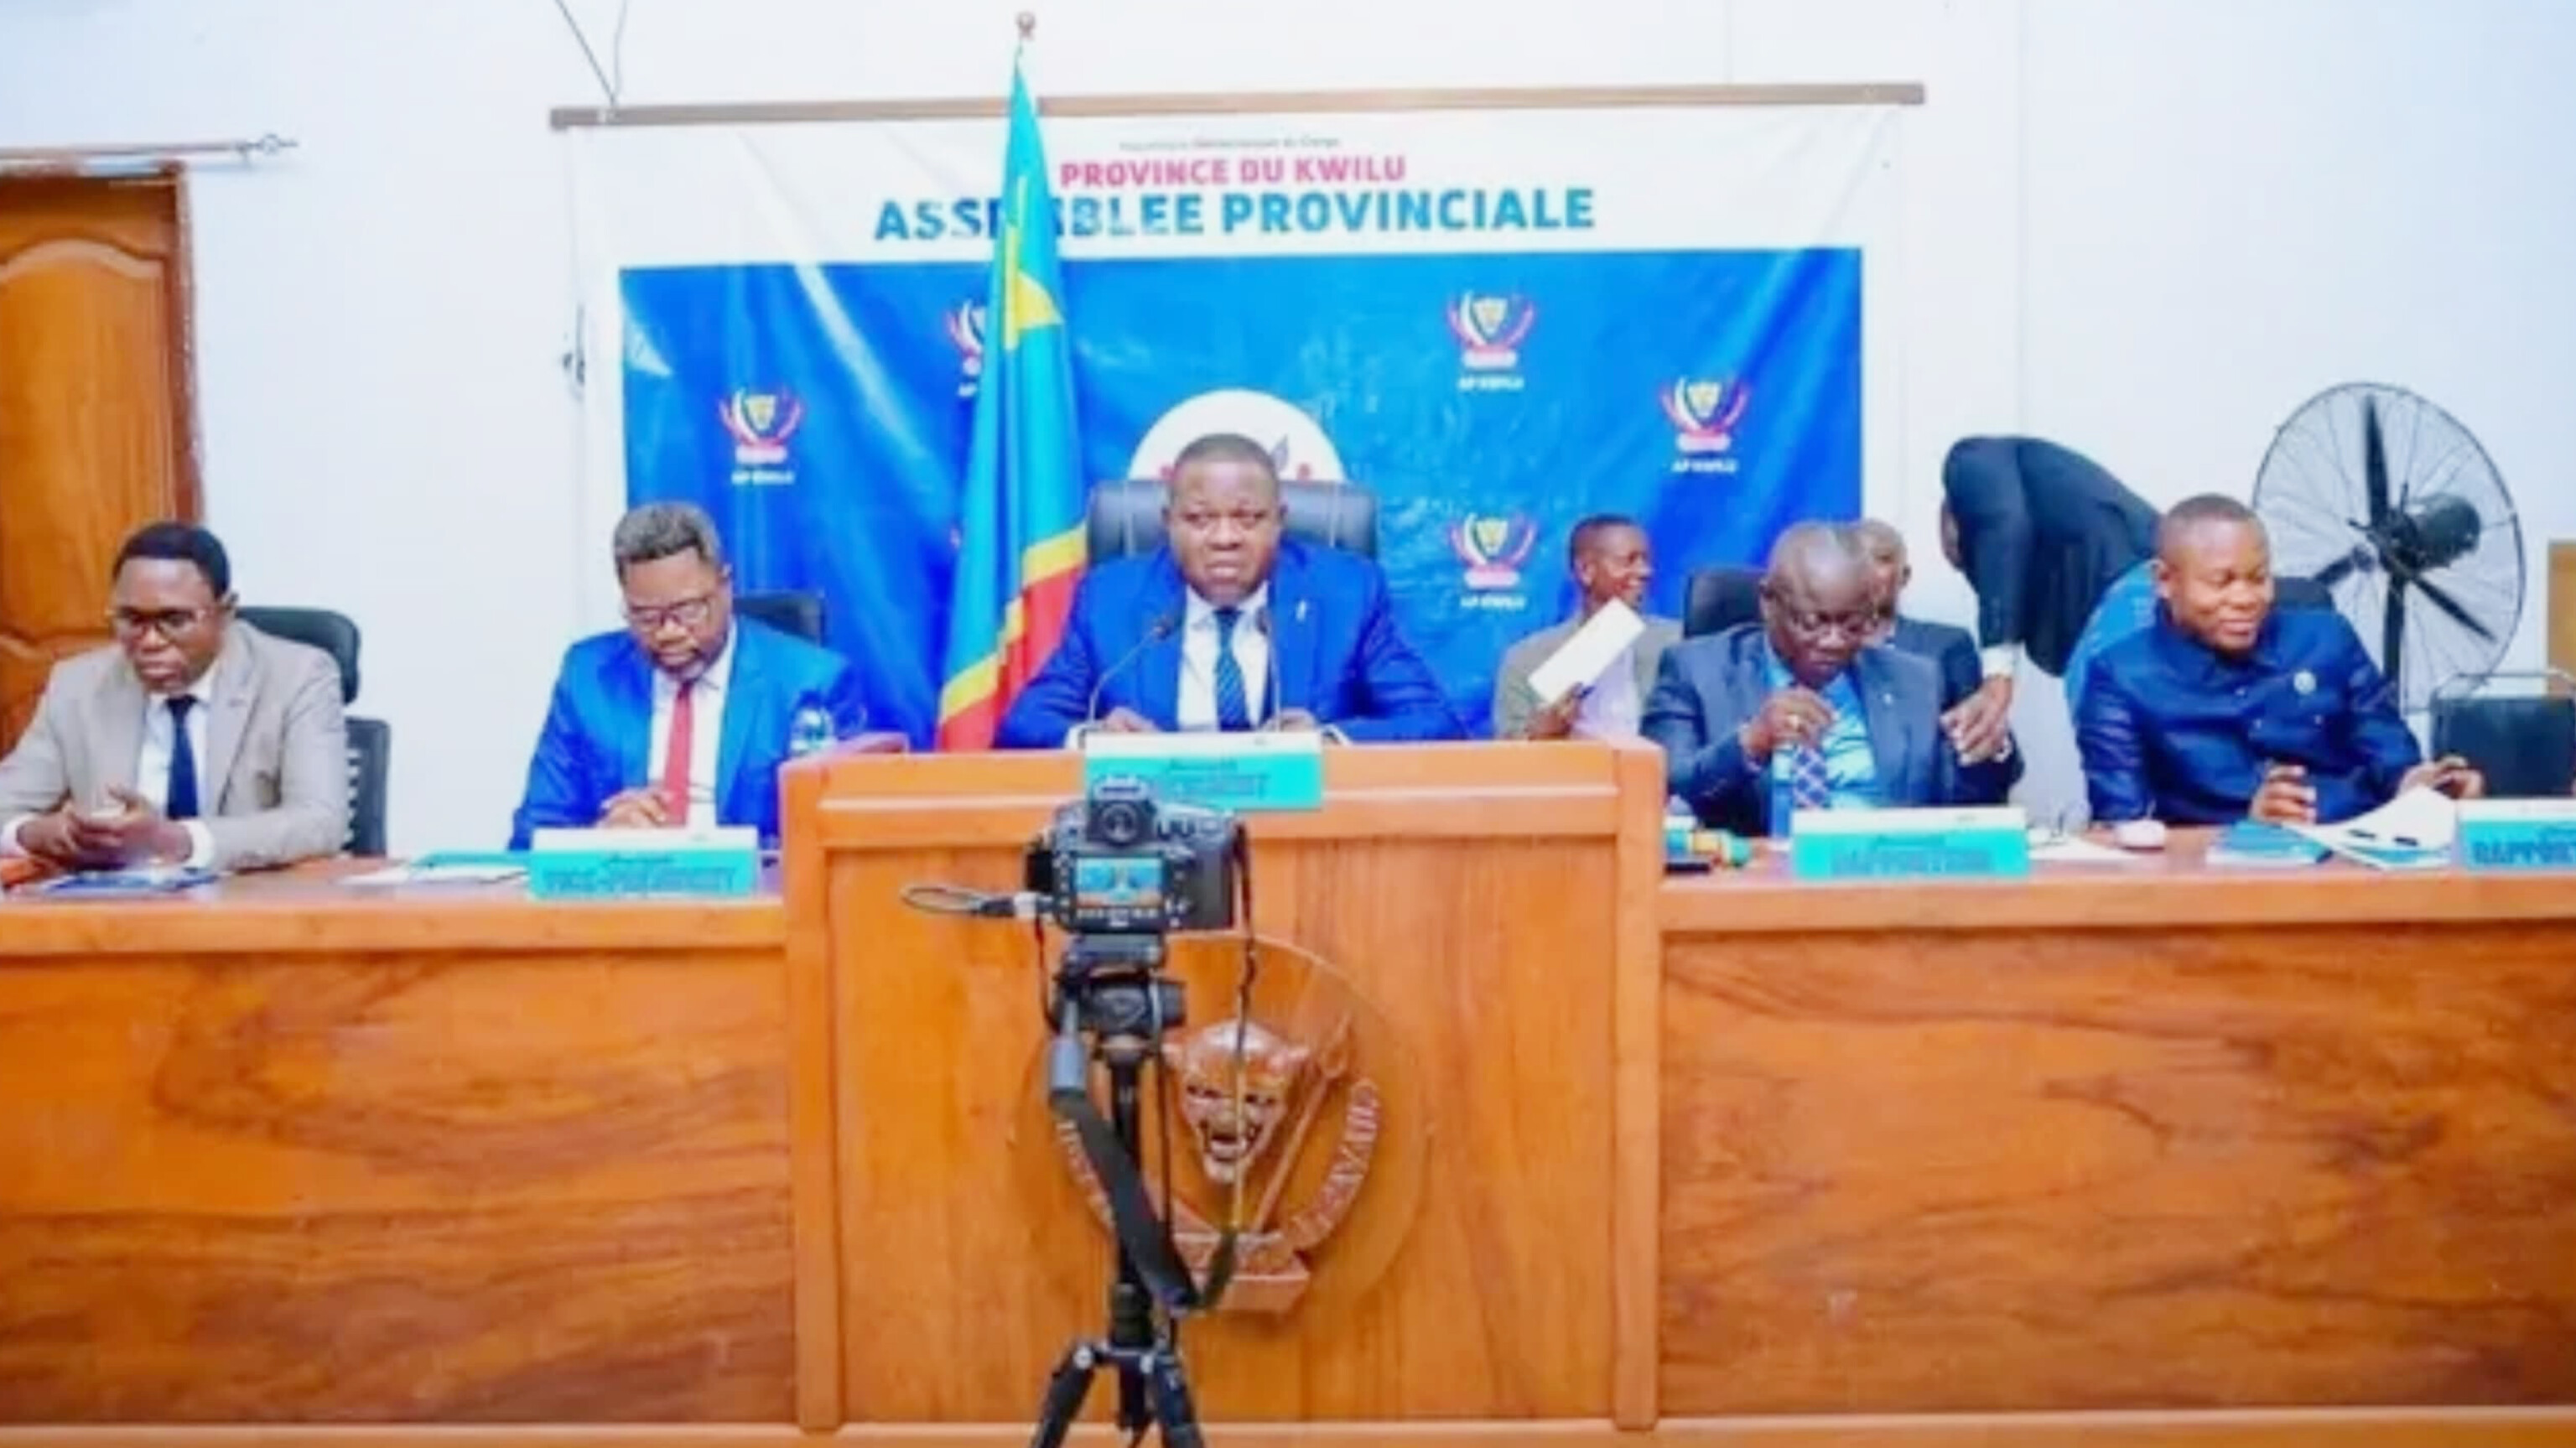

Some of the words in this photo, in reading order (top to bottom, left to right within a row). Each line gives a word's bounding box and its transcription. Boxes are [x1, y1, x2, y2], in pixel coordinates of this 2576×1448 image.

[1060, 158, 1229, 189] PROVINCE
[1240, 157, 1285, 184] DU
[1295, 155, 1407, 182] KWILU
[1221, 188, 1596, 234] PROVINCIALE
